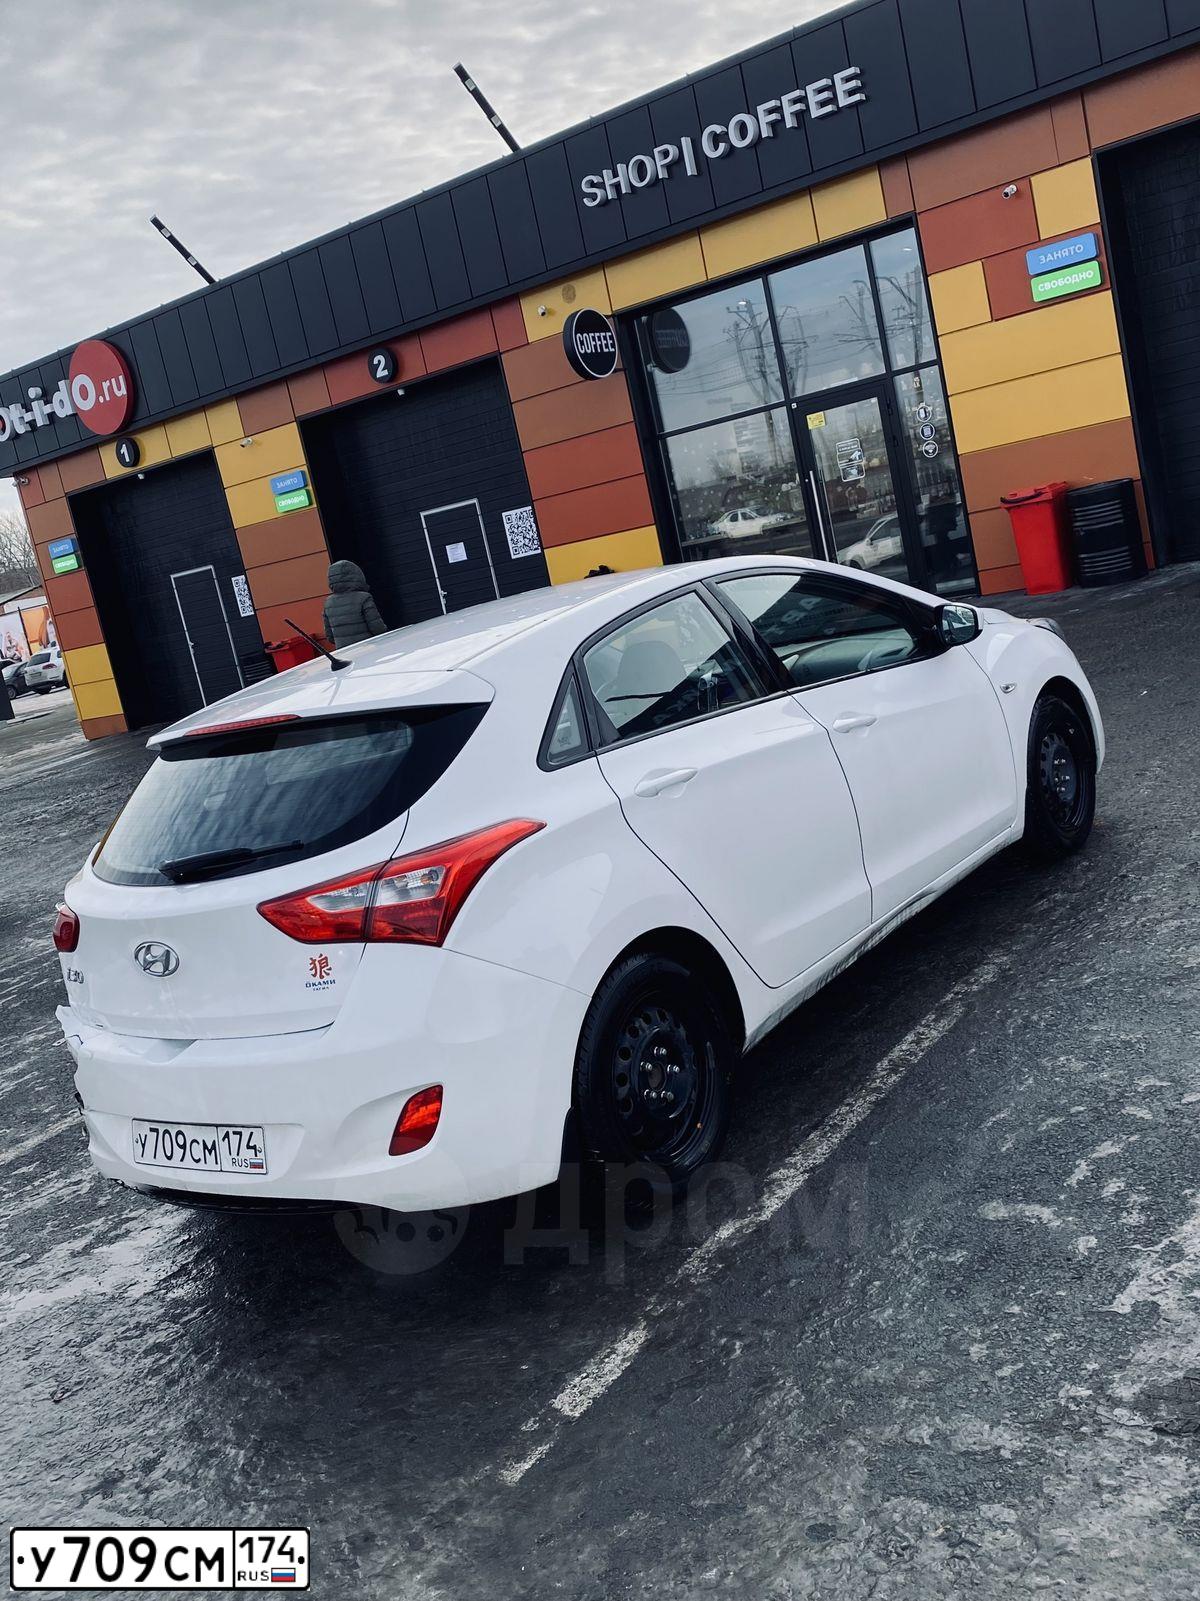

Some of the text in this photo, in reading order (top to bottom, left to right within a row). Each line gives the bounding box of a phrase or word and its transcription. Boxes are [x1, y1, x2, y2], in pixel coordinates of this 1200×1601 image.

[701, 66, 866, 158] COFFEE
[1039, 244, 1084, 264] ЗАНЯТО
[1038, 270, 1094, 292] СВОБОДНО
[576, 332, 615, 354] COFFEE
[373, 354, 389, 378] 2
[120, 443, 130, 463] 1
[221, 1130, 258, 1157] 174
[231, 1157, 249, 1168] RUS
